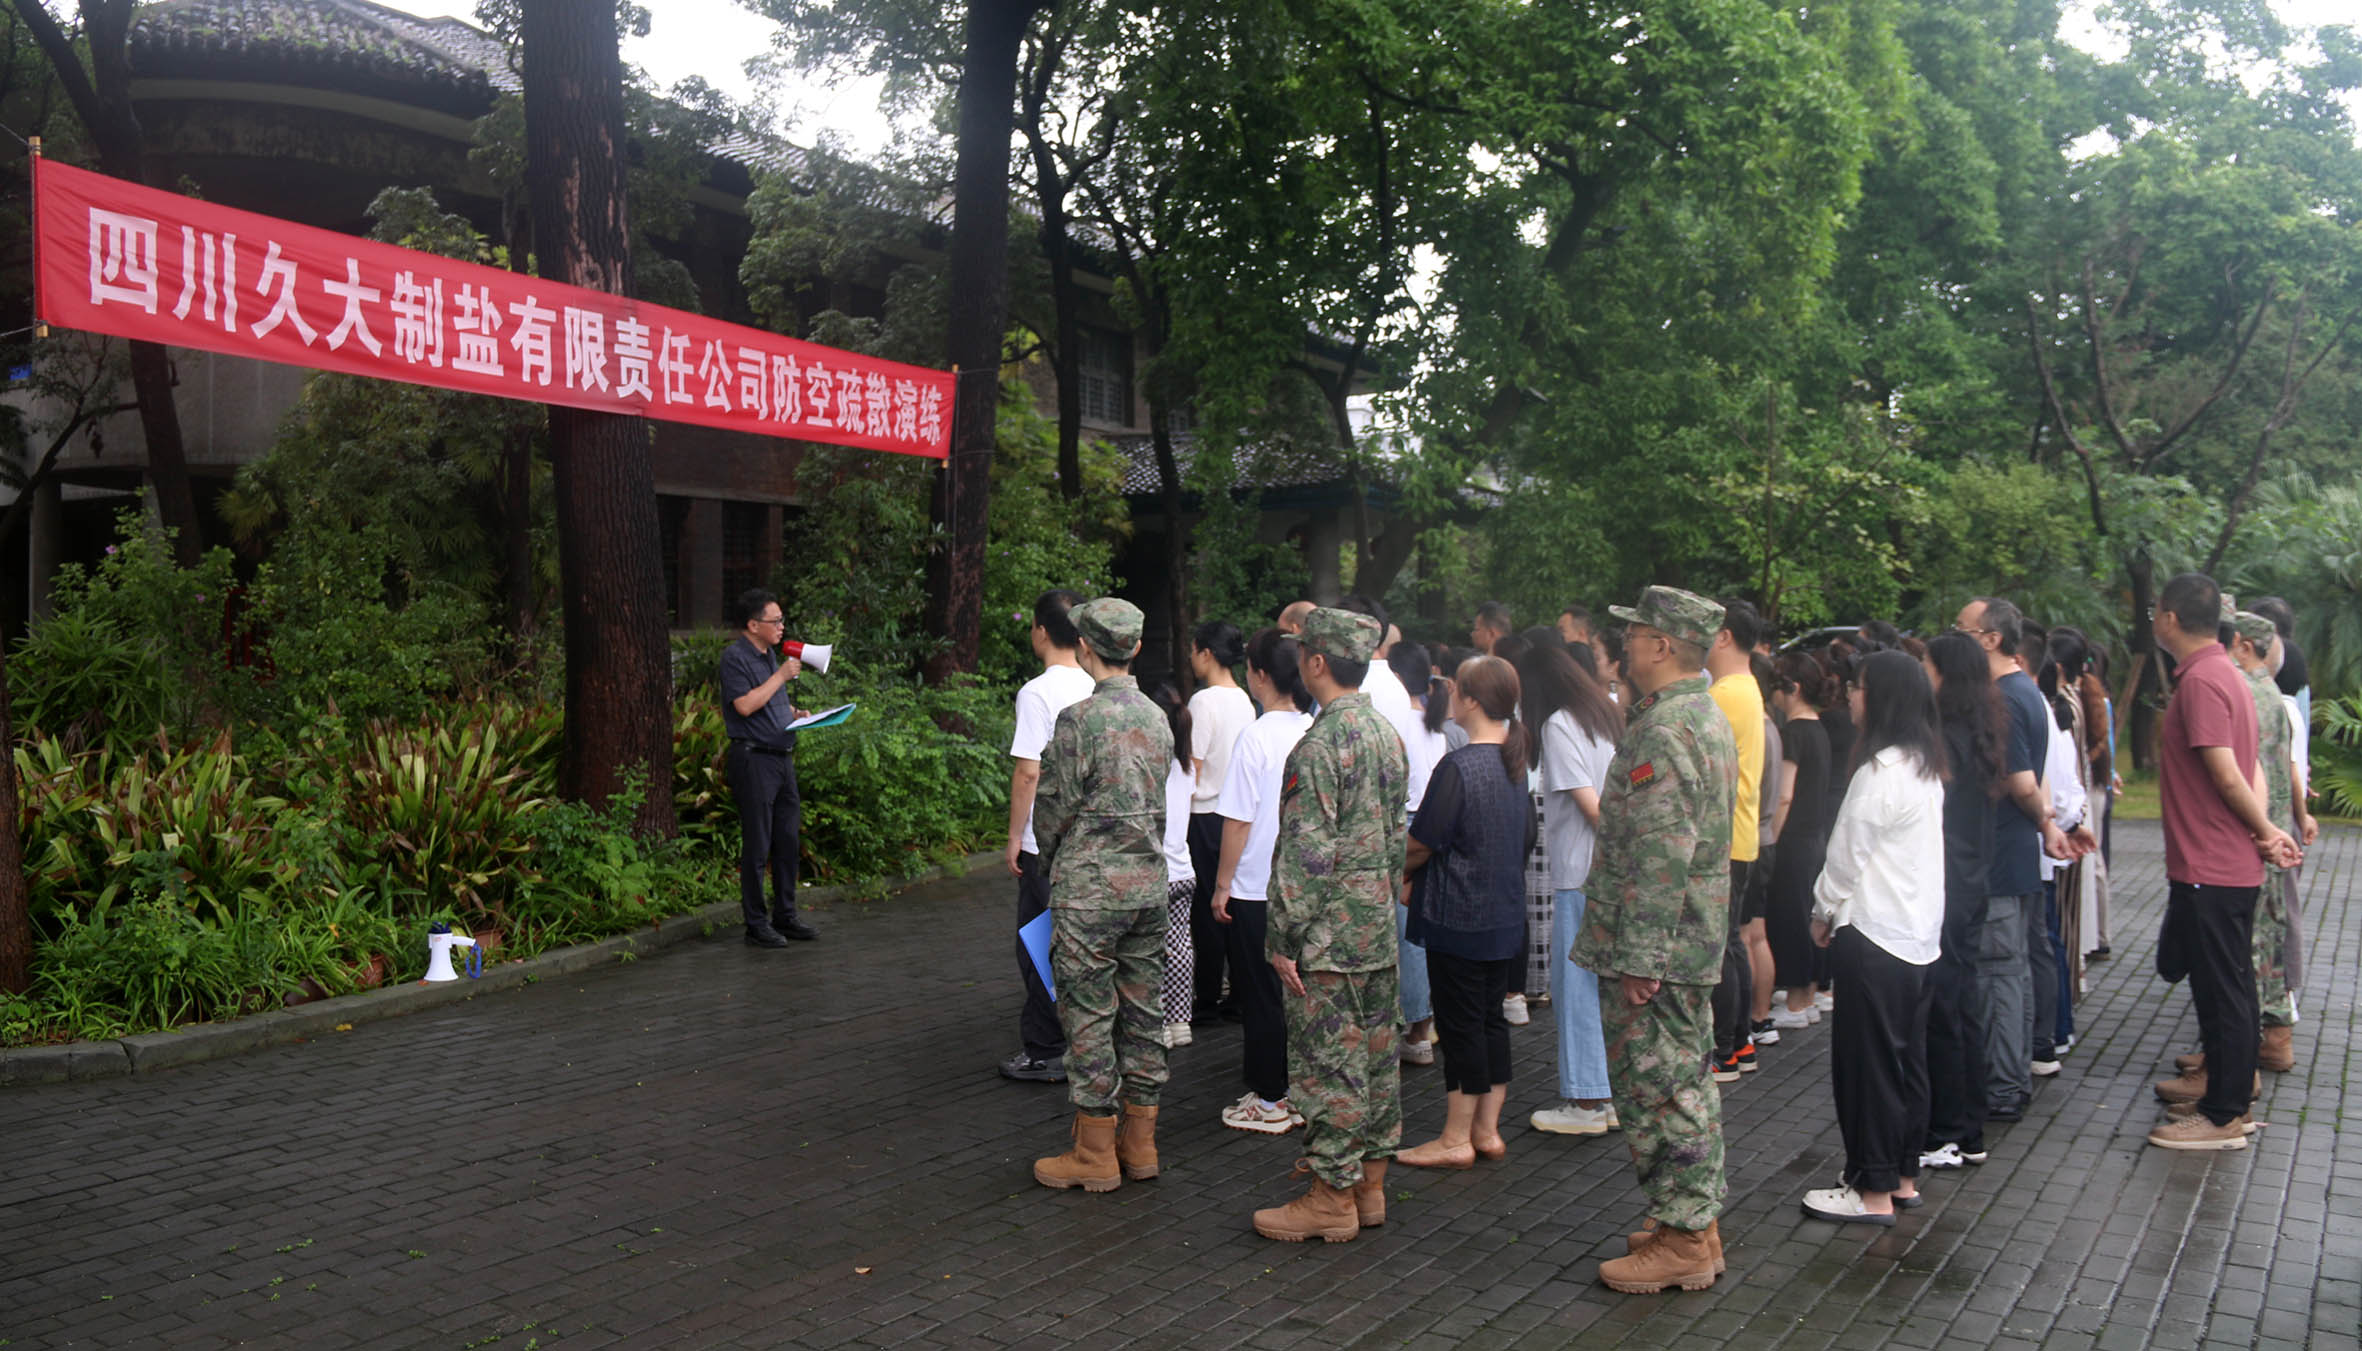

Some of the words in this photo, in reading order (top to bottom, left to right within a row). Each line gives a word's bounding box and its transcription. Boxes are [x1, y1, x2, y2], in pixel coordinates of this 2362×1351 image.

[89, 207, 942, 446] 四川久大制盐有限责任公司防空疏散演练
